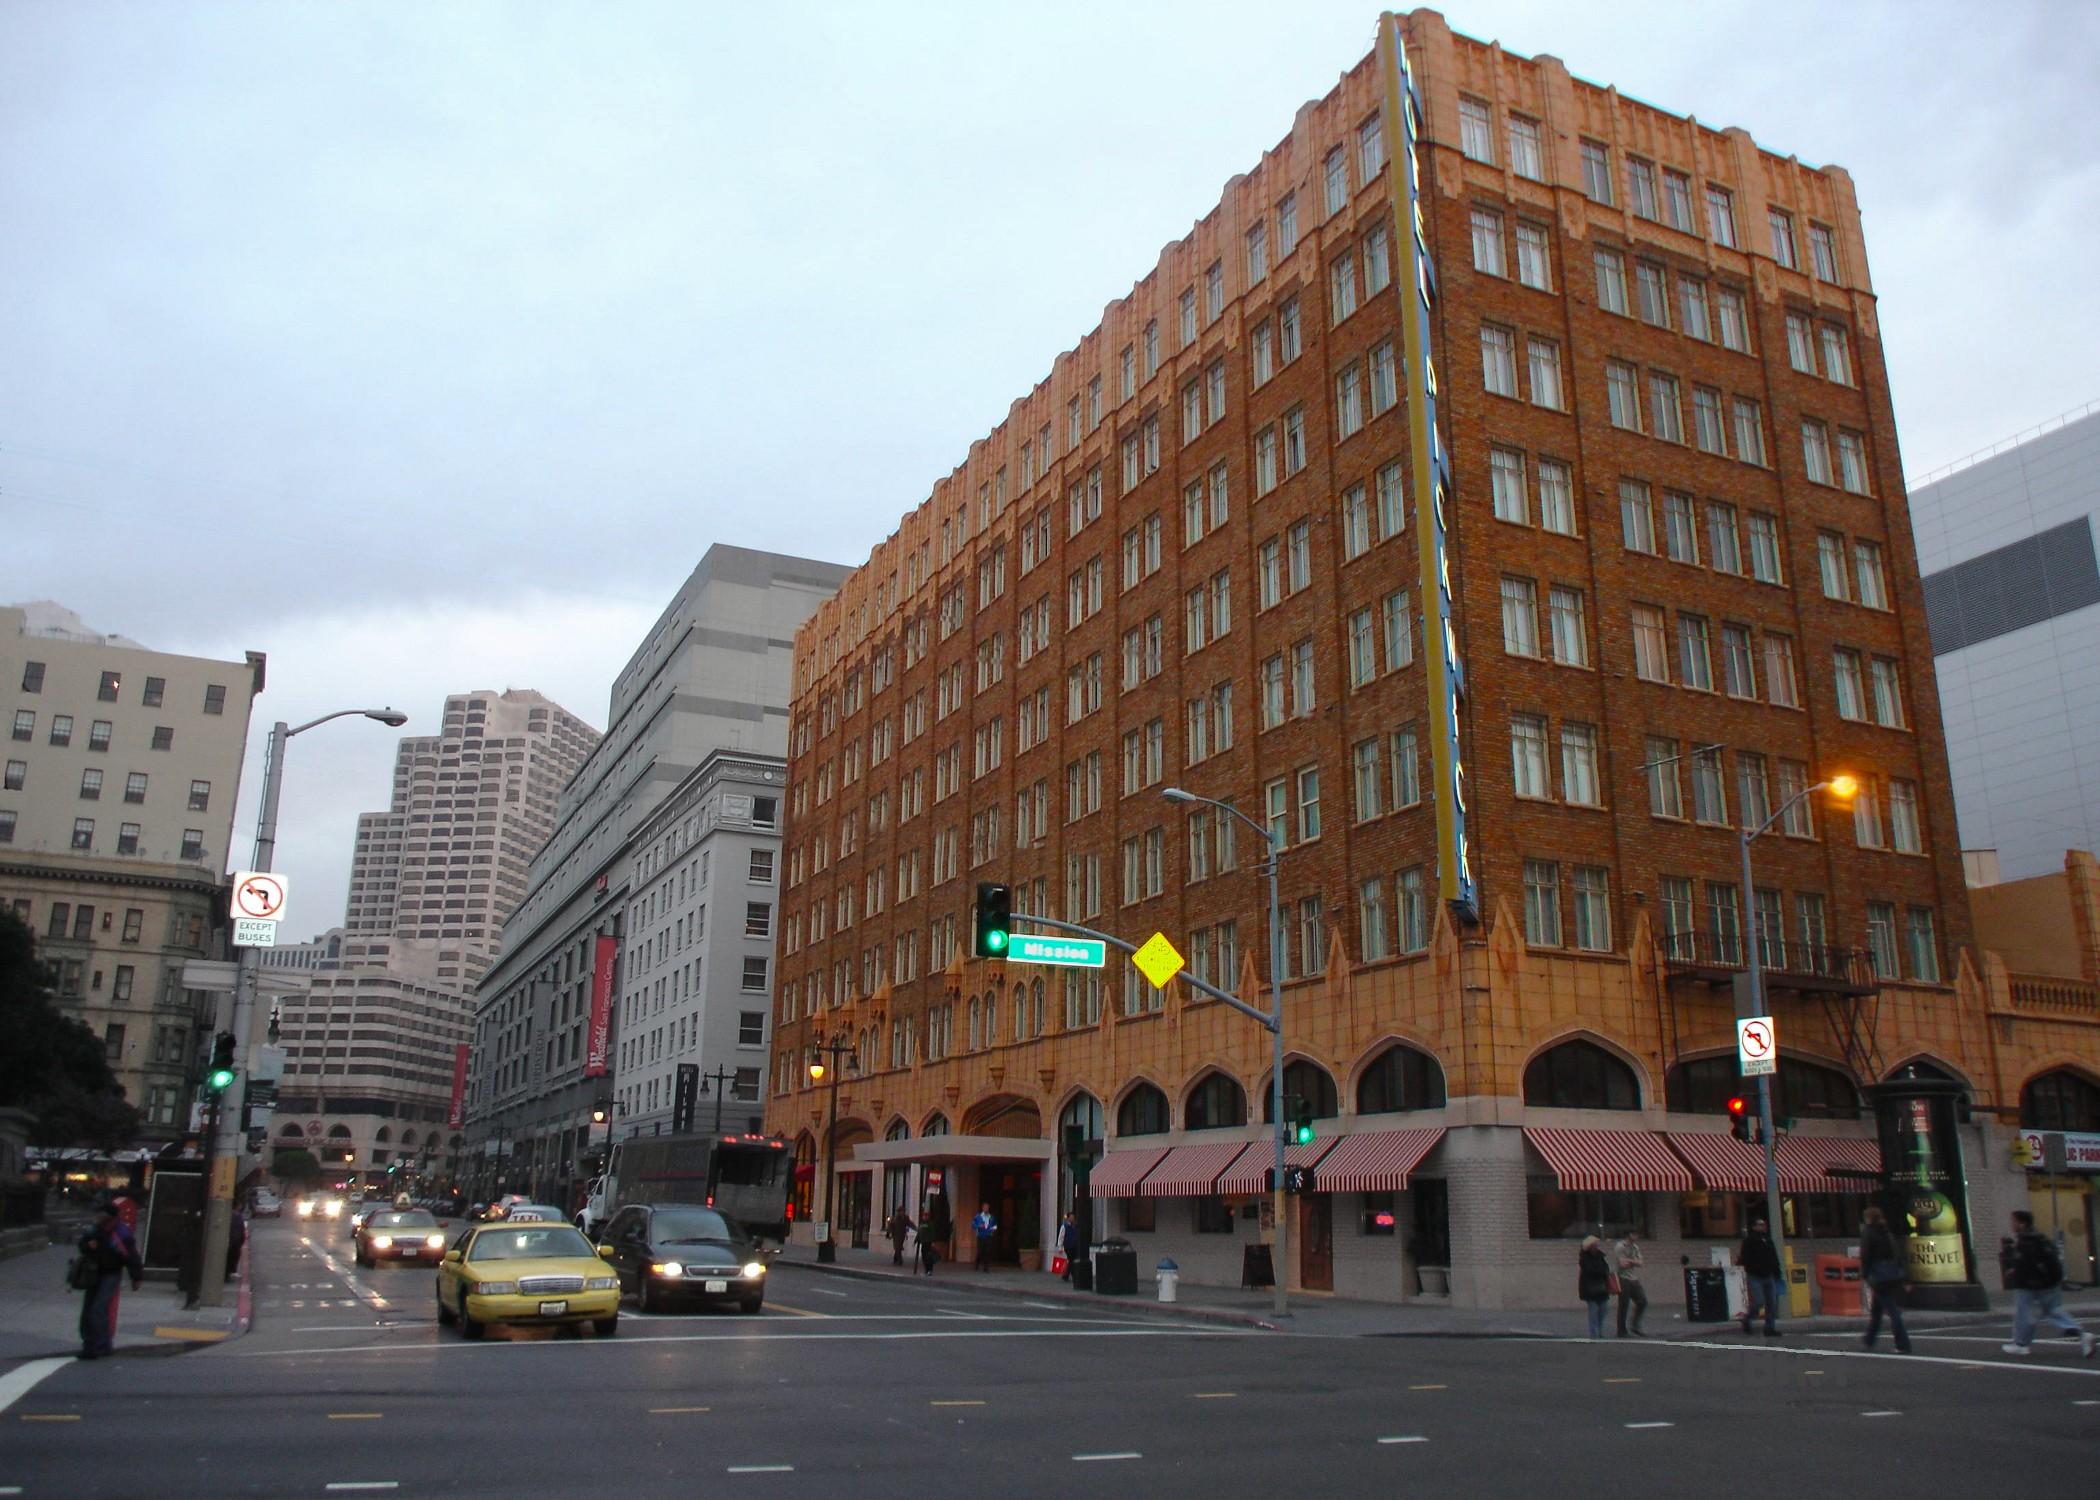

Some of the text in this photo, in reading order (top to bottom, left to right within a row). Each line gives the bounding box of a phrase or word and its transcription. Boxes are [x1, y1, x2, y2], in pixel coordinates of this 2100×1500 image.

[1401, 38, 1471, 887] HOTEL PICKWICK
[240, 922, 272, 931] EXCEPT
[238, 933, 272, 942] BUSES
[1024, 942, 1089, 960] Mission
[590, 1025, 606, 1067] Westfield
[513, 1215, 538, 1223] TAXI
[1915, 1243, 1937, 1253] THE
